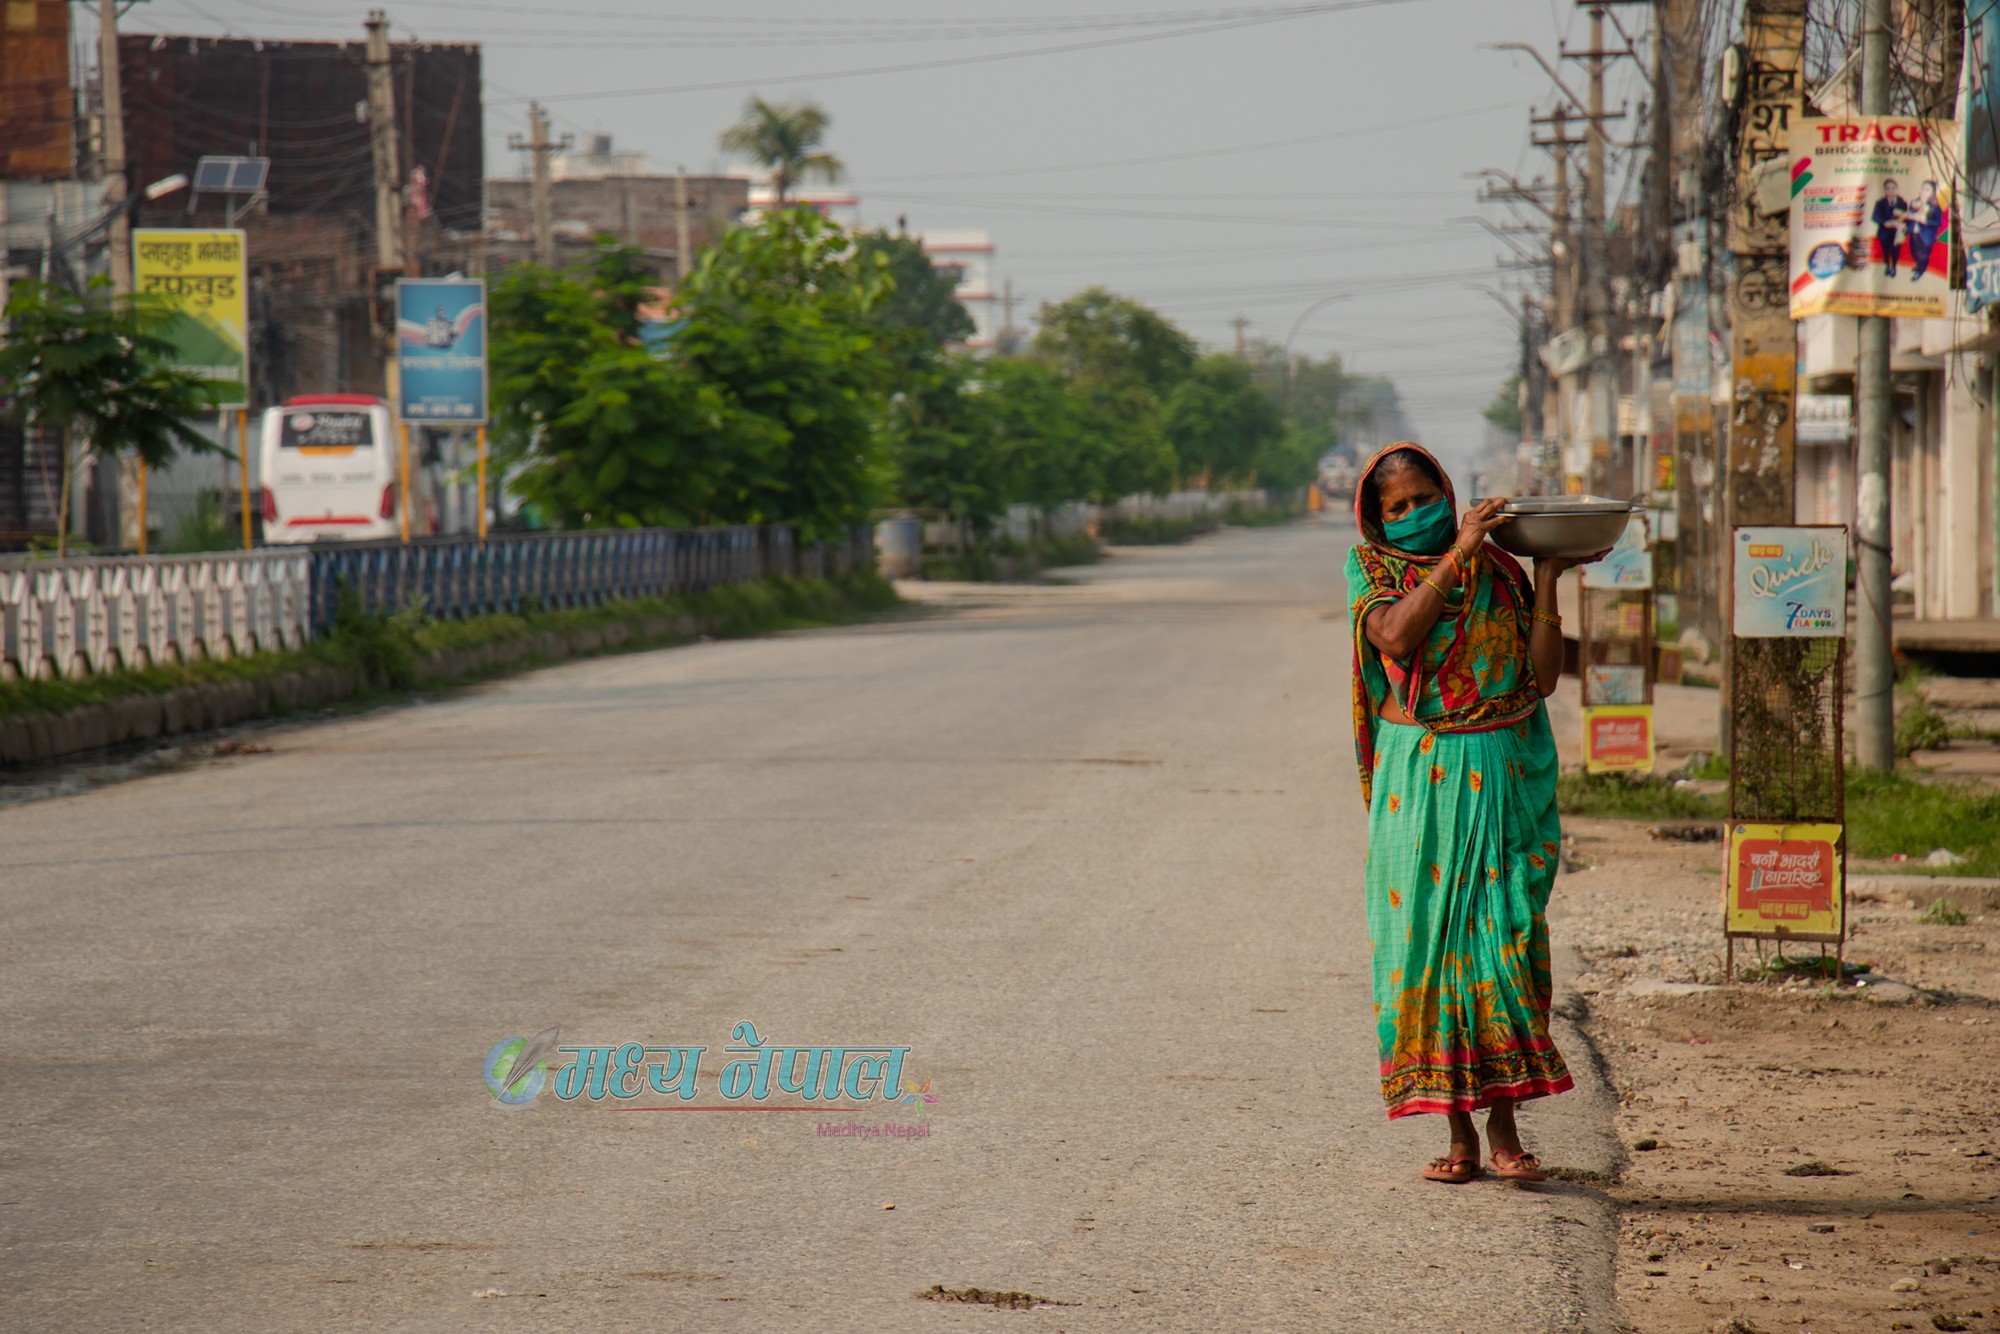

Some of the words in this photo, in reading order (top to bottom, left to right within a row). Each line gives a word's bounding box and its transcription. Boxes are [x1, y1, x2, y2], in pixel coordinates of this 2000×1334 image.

[1816, 123, 1931, 145] TRACK
[1815, 145, 1869, 155] BRIDGE
[1750, 538, 1833, 599] Quick
[1785, 601, 1803, 630] 7
[1800, 610, 1832, 618] DAYS
